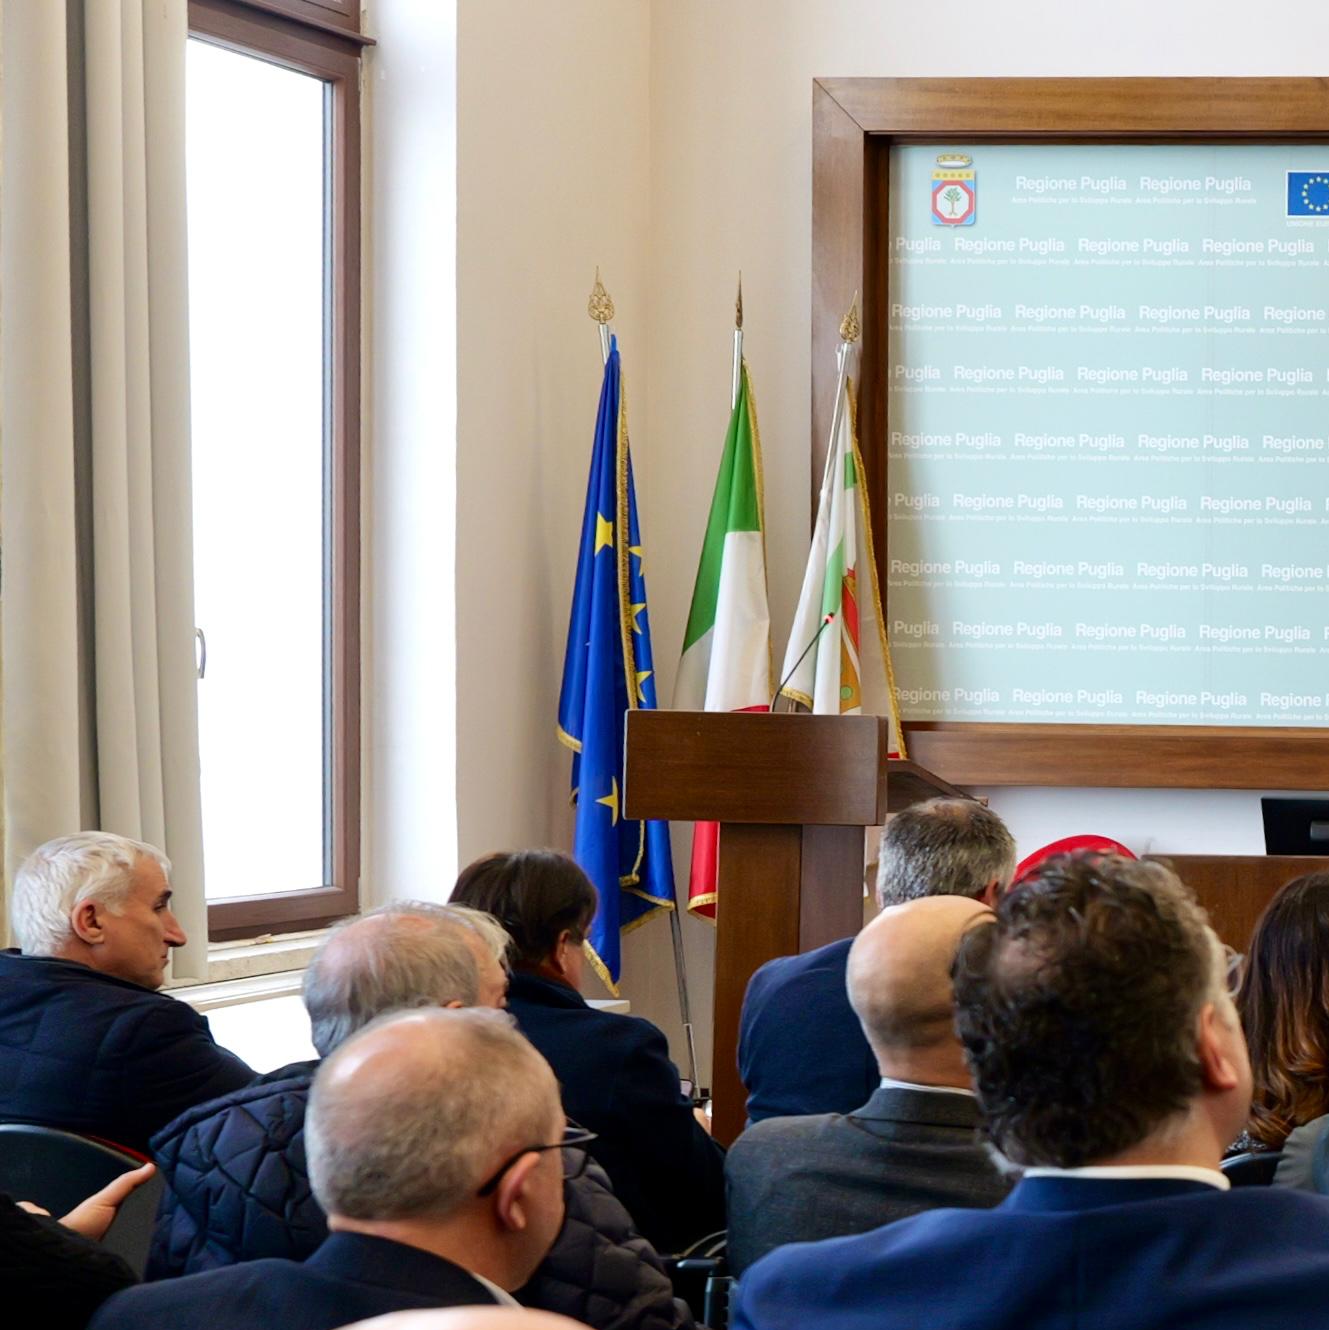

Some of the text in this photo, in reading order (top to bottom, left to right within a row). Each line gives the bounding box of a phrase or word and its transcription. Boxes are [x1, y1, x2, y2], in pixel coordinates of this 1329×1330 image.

[1015, 175, 1252, 194] Regione Puglia Regione Puglia
[895, 236, 941, 254] Puglia
[953, 237, 1016, 255] Regione
[1018, 237, 1066, 255] Puglia
[1077, 238, 1140, 256] Regione
[1142, 238, 1190, 256] Puglia
[1201, 238, 1265, 256] Regione
[1267, 238, 1315, 256] Puglia
[891, 303, 953, 321] Regione
[955, 303, 1003, 321] Puglia
[1014, 304, 1077, 322] Regione
[1079, 304, 1127, 322] Puglia
[1138, 305, 1201, 323] Regione
[1203, 305, 1251, 323] Puglia
[1263, 306, 1327, 324] Regione
[895, 364, 941, 382] Puglia
[951, 365, 1015, 383] Regione
[1017, 366, 1065, 384] Puglia
[1076, 366, 1139, 384] Regione
[1141, 366, 1189, 385] Puglia
[1201, 367, 1265, 385] Regione
[1266, 367, 1314, 385] Puglia
[891, 431, 953, 449] Regione
[955, 432, 1003, 450] Puglia
[1014, 432, 1076, 450] Regione
[1078, 433, 1126, 451] Puglia
[1137, 433, 1201, 451] Regione
[1202, 434, 1250, 452] Puglia
[1261, 434, 1325, 452] Regione
[894, 492, 940, 510] Puglia
[951, 493, 1015, 511] Regione
[1017, 494, 1065, 512] Puglia
[1075, 494, 1139, 512] Regione
[1140, 495, 1188, 513] Puglia
[1199, 495, 1263, 513] Regione
[1265, 496, 1313, 514] Puglia
[889, 559, 952, 577] Regione
[954, 560, 1001, 578] Puglia
[1012, 560, 1075, 578] Regione
[1077, 561, 1125, 579] Puglia
[1136, 562, 1199, 580] Regione
[1201, 562, 1249, 581] Puglia
[1261, 563, 1324, 581] Regione
[893, 620, 939, 638] Puglia
[951, 621, 1014, 639] Regione
[1016, 622, 1064, 640] Puglia
[1073, 622, 1137, 640] Regione
[1139, 623, 1187, 641] Puglia
[1198, 624, 1262, 642] Regione
[1264, 625, 1312, 643] Puglia
[953, 687, 1001, 705] Puglia
[1012, 688, 1075, 706] Regione
[1076, 689, 1124, 707] Puglia
[1135, 690, 1198, 708] Regione
[1200, 691, 1248, 709] Puglia
[1259, 692, 1323, 710] Regione
